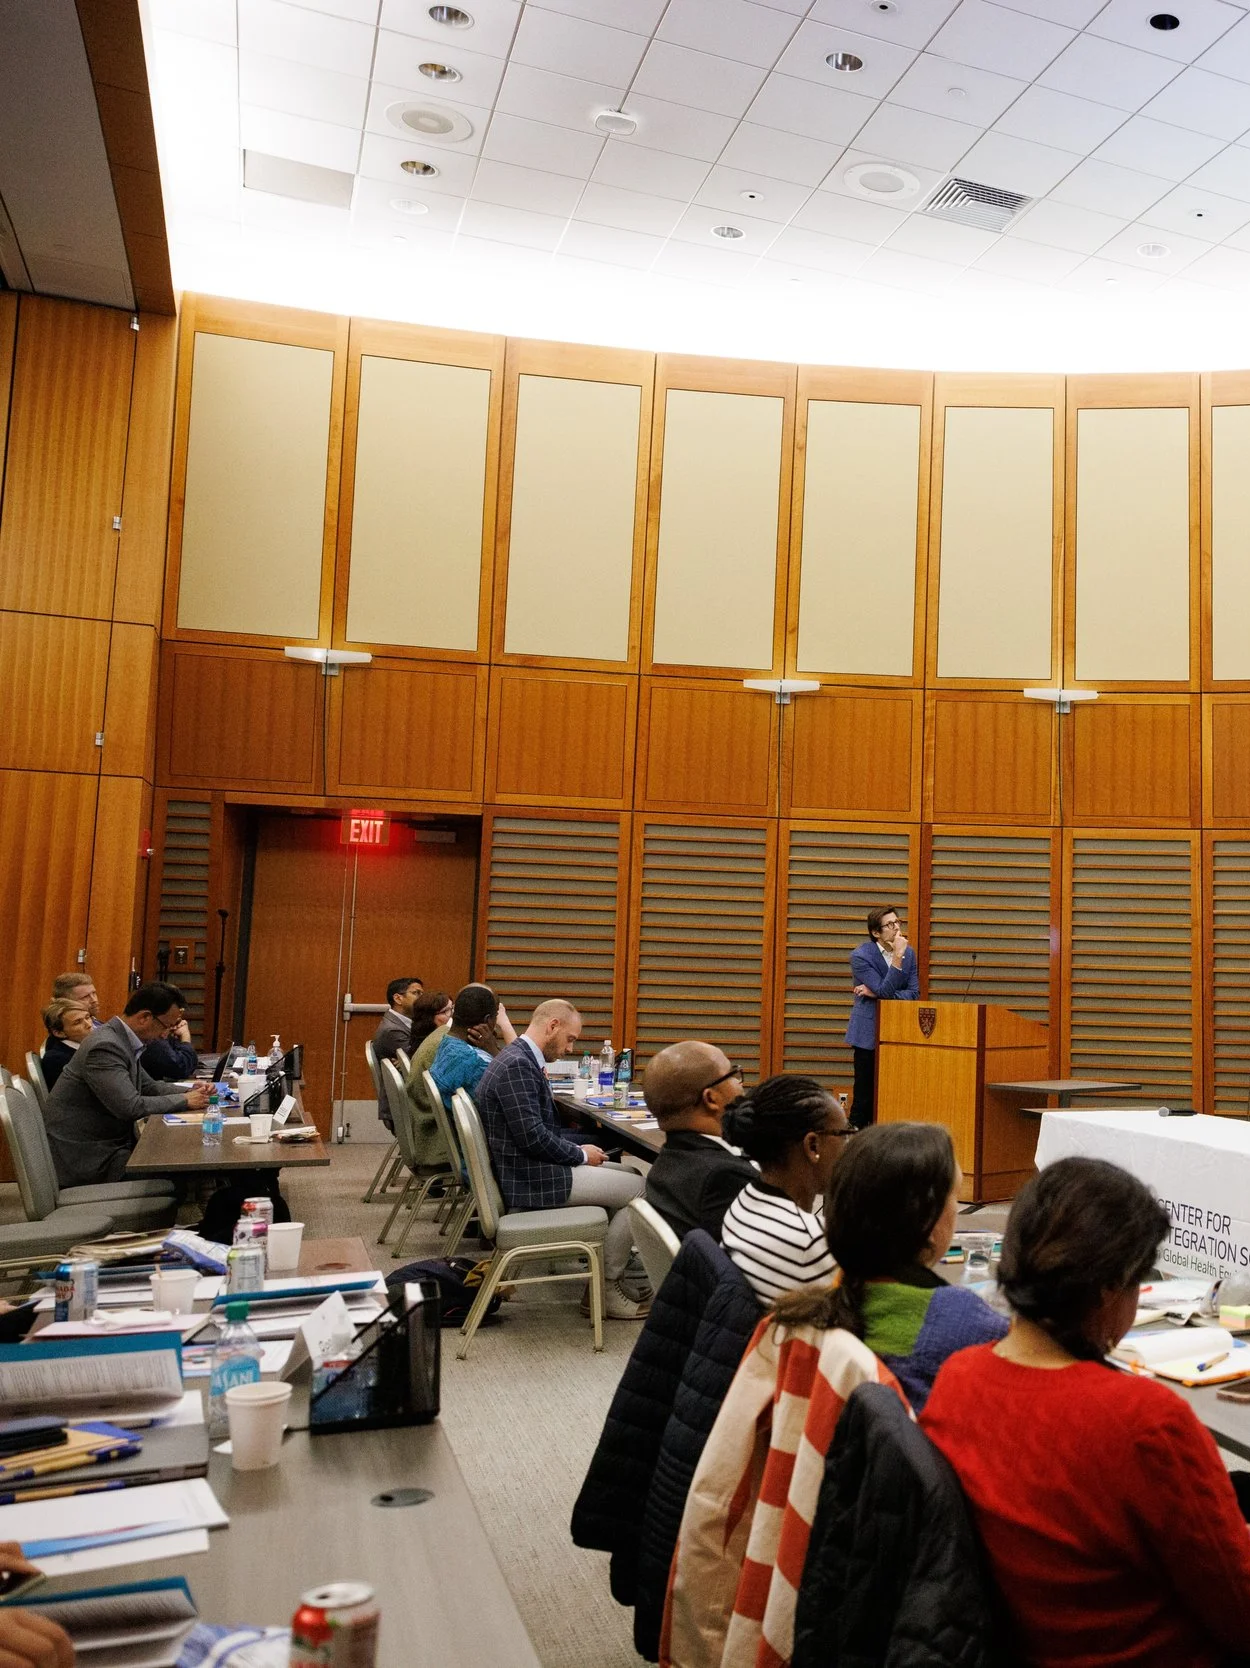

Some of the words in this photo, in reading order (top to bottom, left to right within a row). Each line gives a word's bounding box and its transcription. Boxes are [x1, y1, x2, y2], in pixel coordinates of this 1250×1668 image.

[350, 819, 383, 843] EXIT
[1206, 1211, 1231, 1235] FOR
[1164, 1226, 1237, 1264] TEGRATION
[1163, 1248, 1189, 1268] Global
[1191, 1256, 1217, 1277] Health
